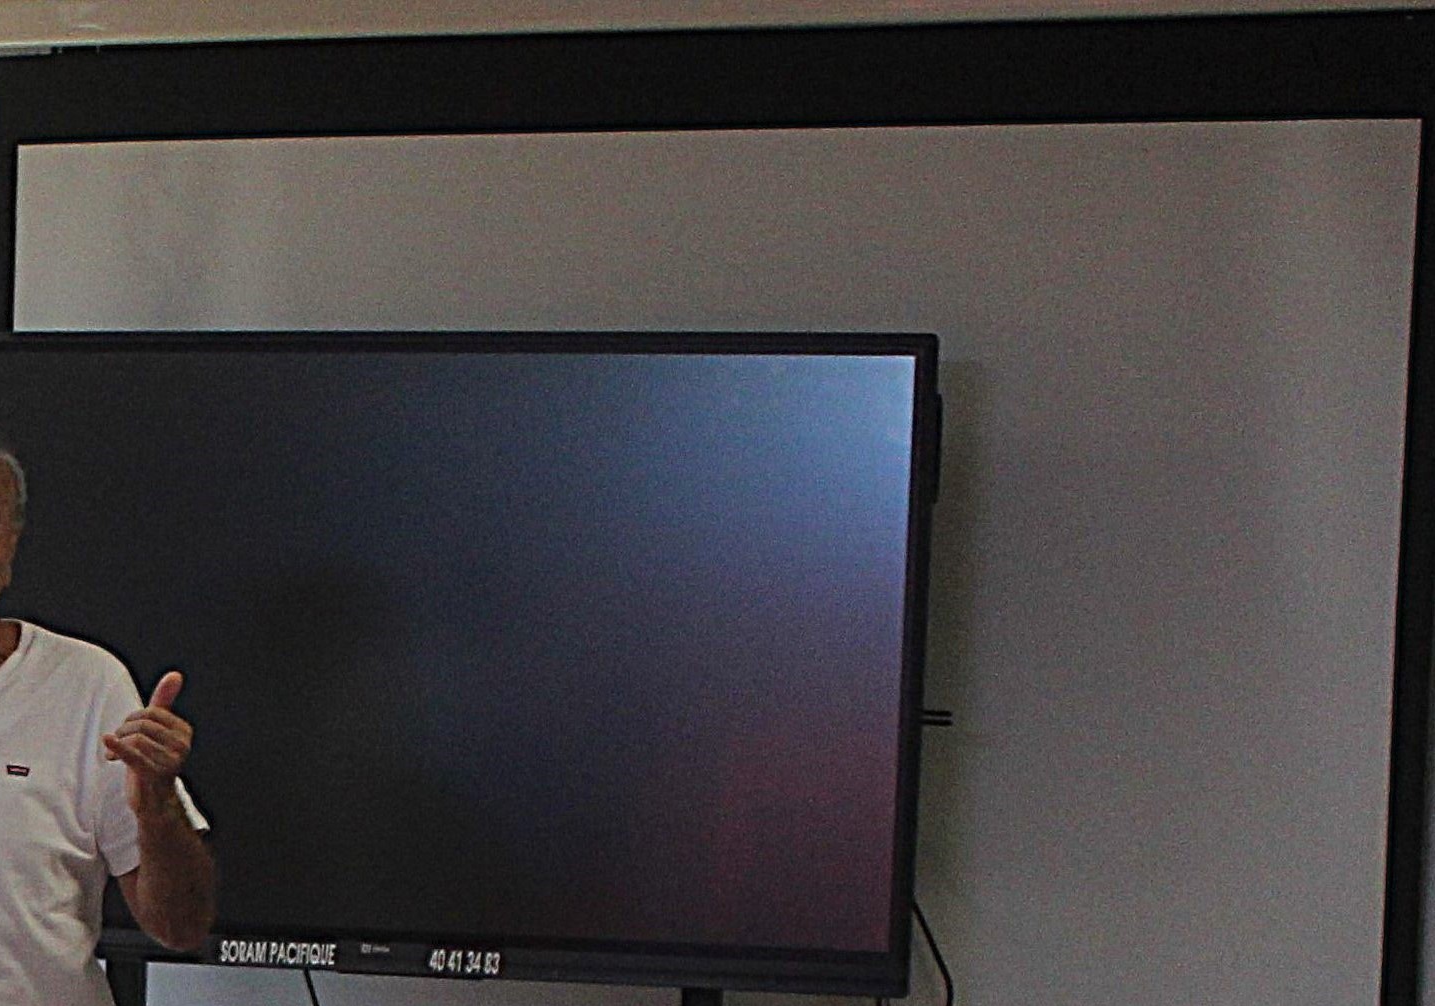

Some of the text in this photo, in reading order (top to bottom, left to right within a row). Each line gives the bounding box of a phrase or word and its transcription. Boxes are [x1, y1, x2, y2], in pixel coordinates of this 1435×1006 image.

[268, 941, 337, 966] PACIFIQUE
[428, 948, 446, 972] 40
[447, 950, 463, 973] 41
[465, 950, 483, 974] 34
